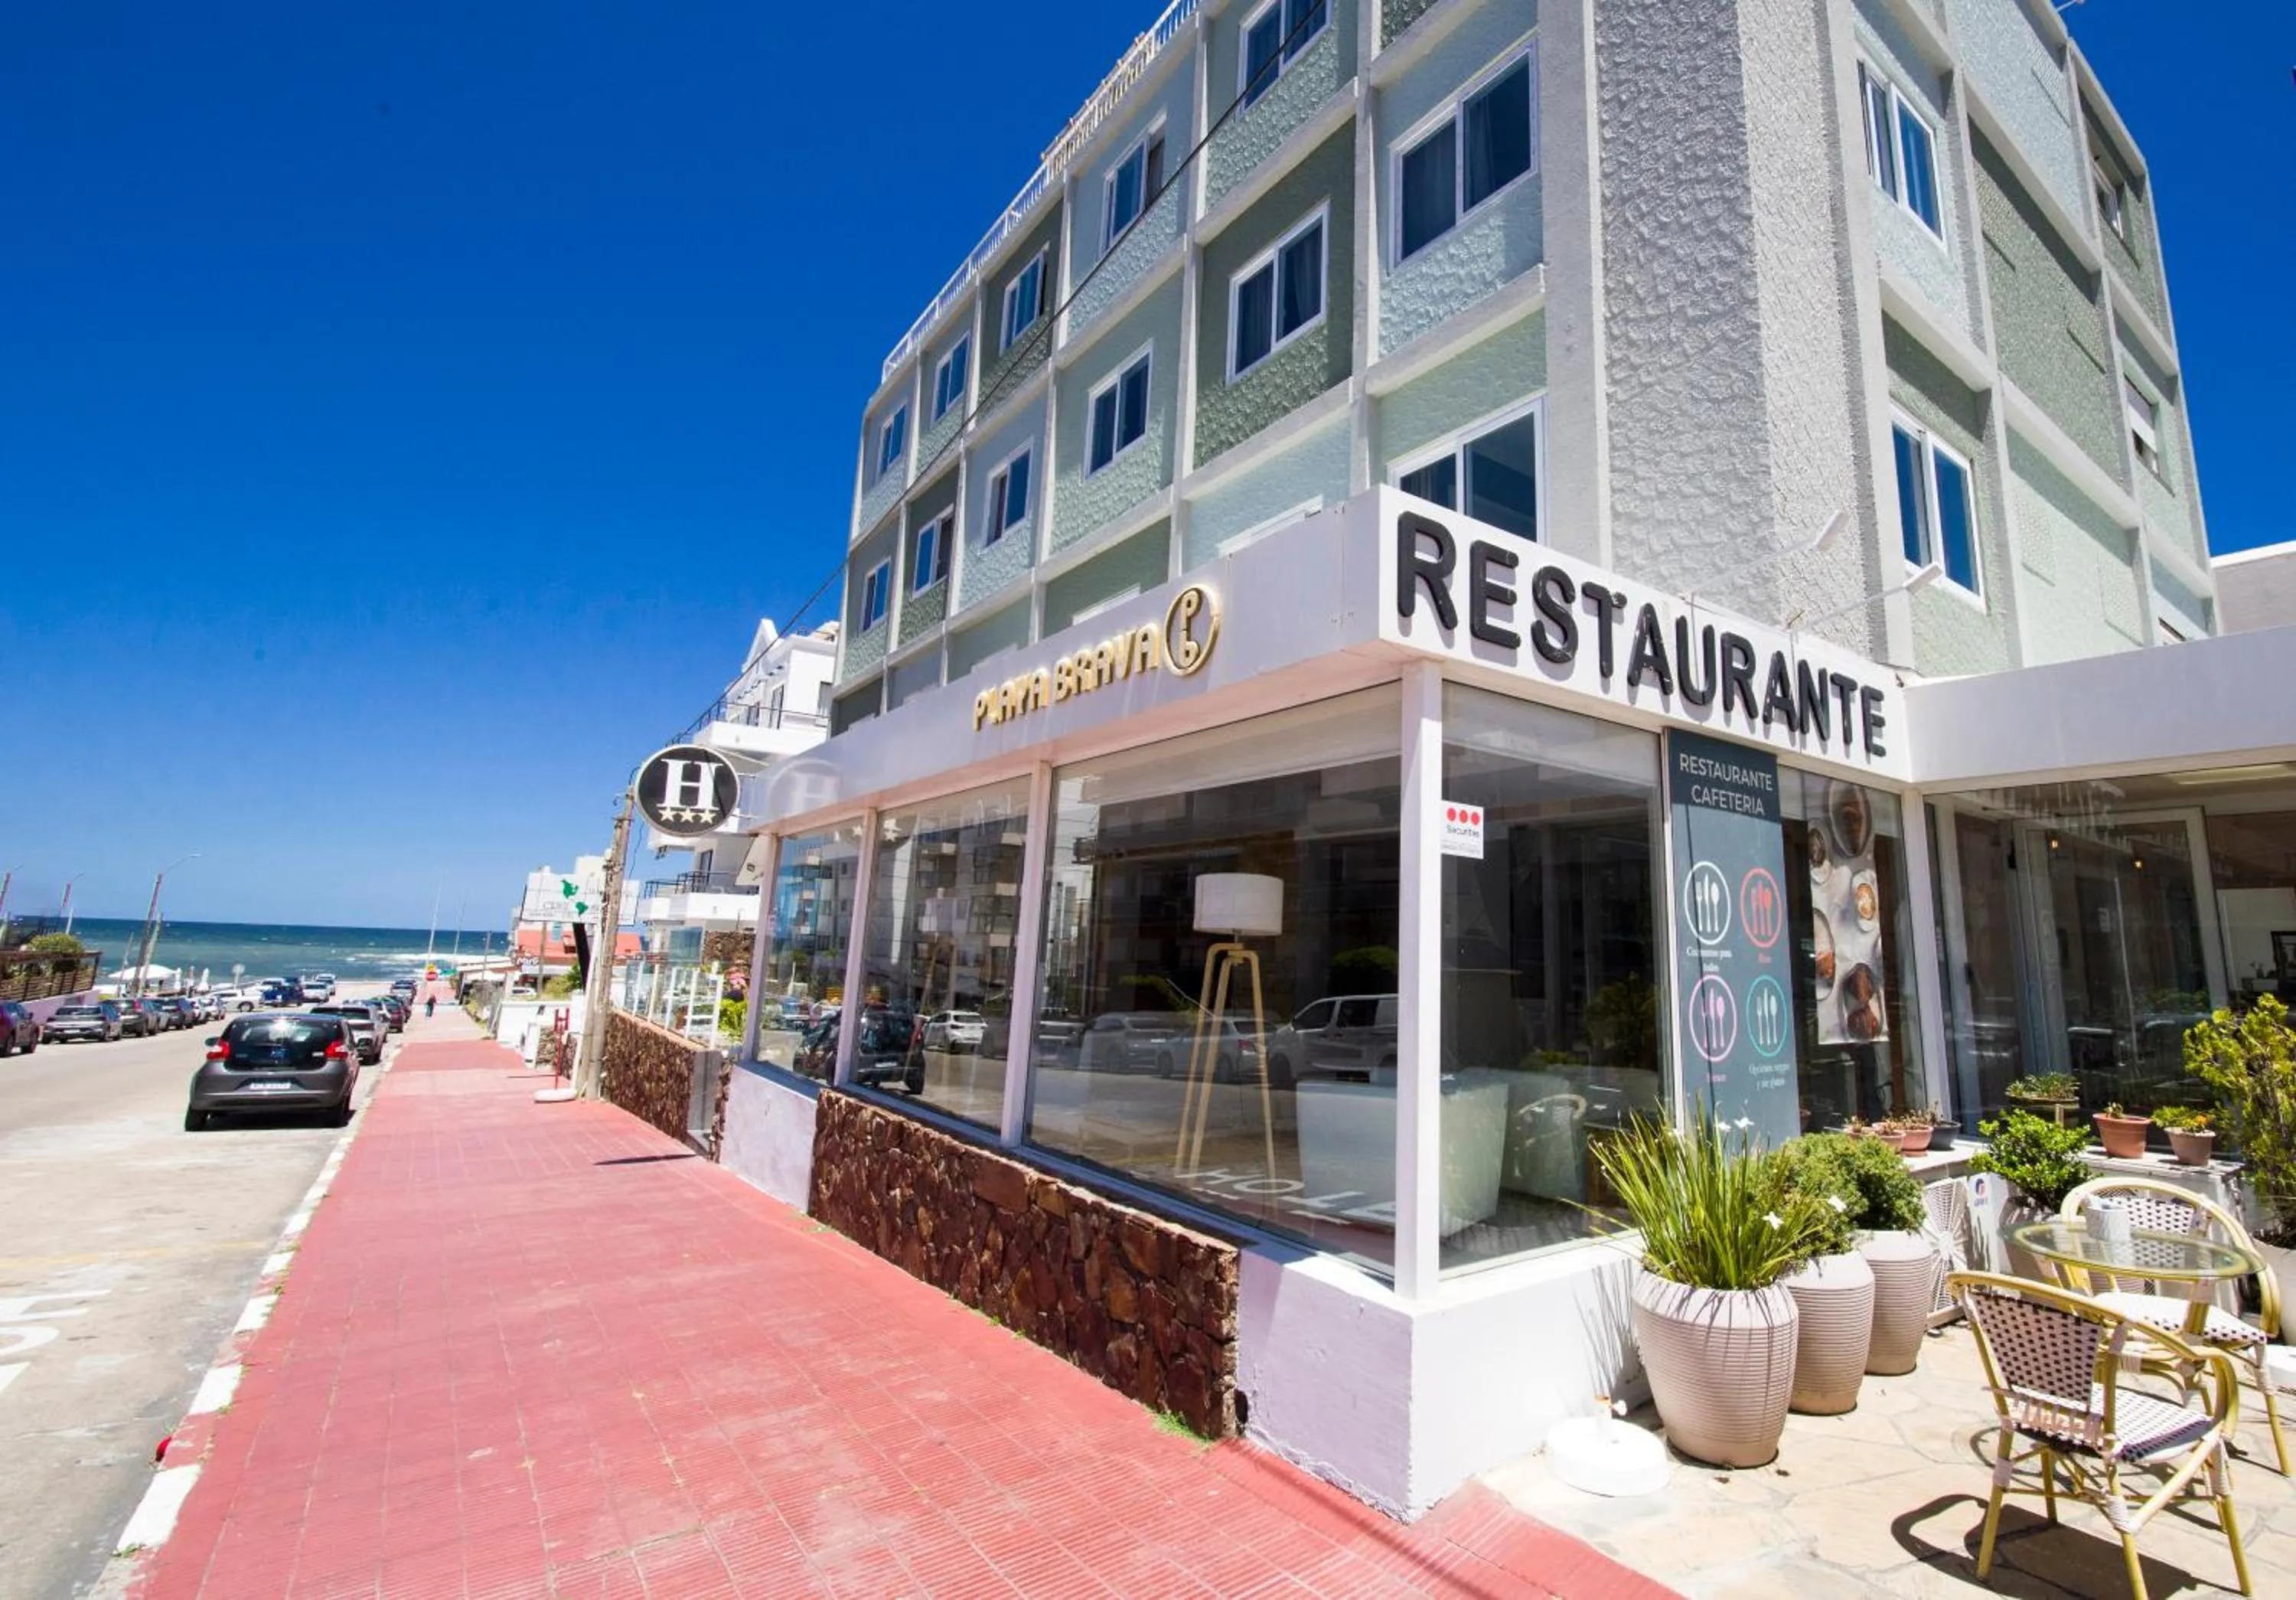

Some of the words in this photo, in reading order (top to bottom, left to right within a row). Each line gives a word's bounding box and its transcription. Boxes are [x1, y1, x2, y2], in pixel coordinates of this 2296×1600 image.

[1397, 511, 1887, 758] RESTAURANTE
[974, 668, 1050, 731] PLAYA
[1053, 622, 1161, 703] BRAVA
[656, 759, 724, 811] H
[1679, 753, 1773, 792] RESTAURANTE
[1691, 785, 1765, 816] CAFETERIA
